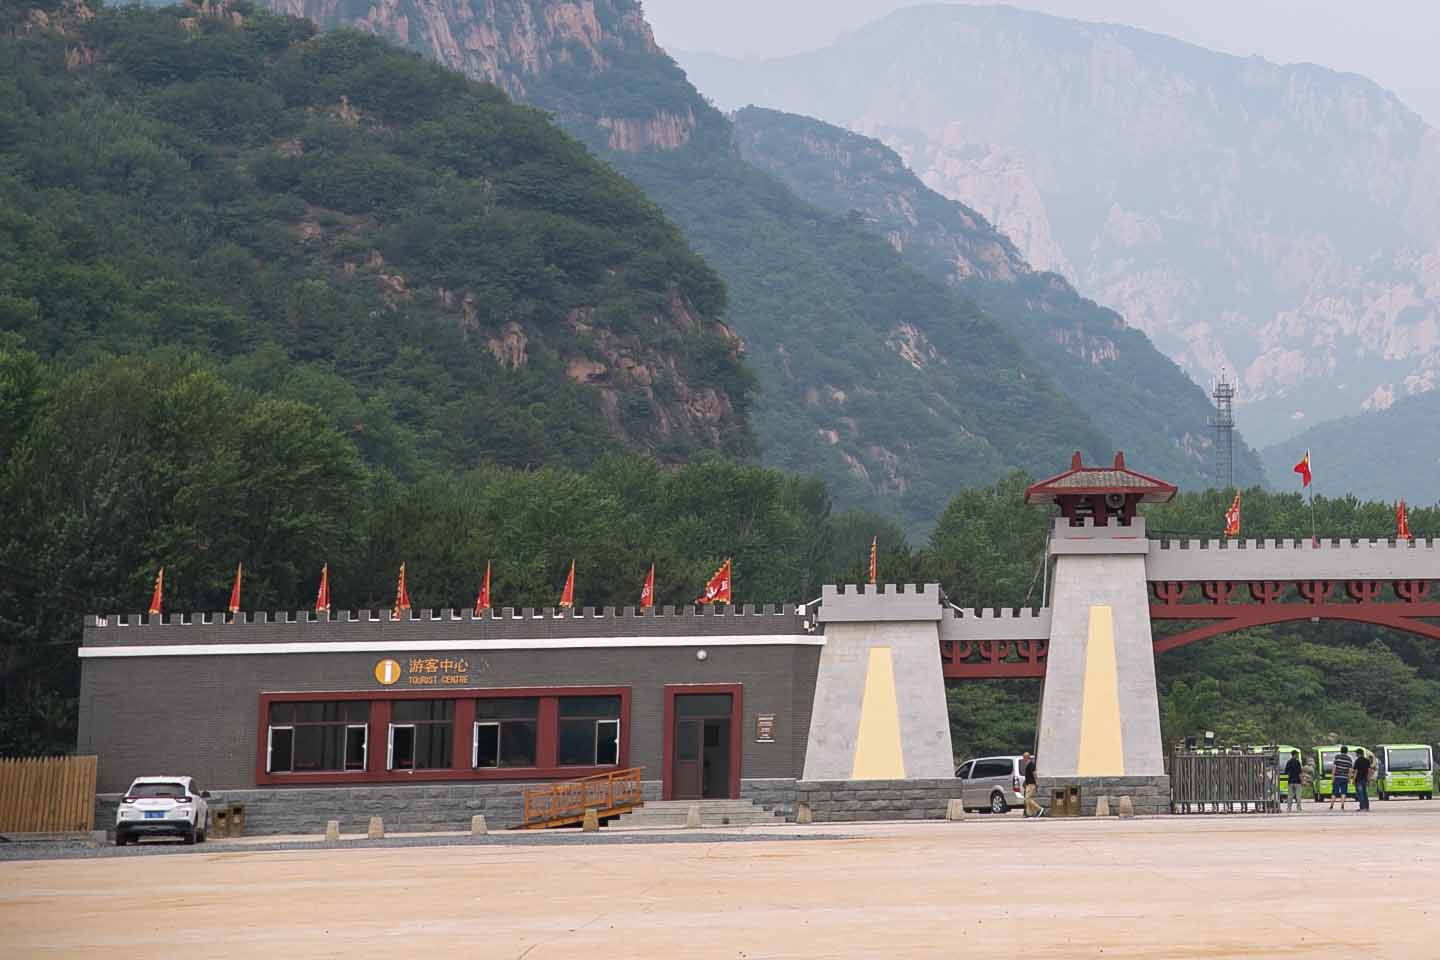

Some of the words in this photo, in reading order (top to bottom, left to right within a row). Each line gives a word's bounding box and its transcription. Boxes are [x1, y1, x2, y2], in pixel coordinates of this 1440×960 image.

[409, 657, 469, 673] 游客中心
[408, 675, 438, 685] TOURIST
[441, 675, 469, 685] CENTRE
